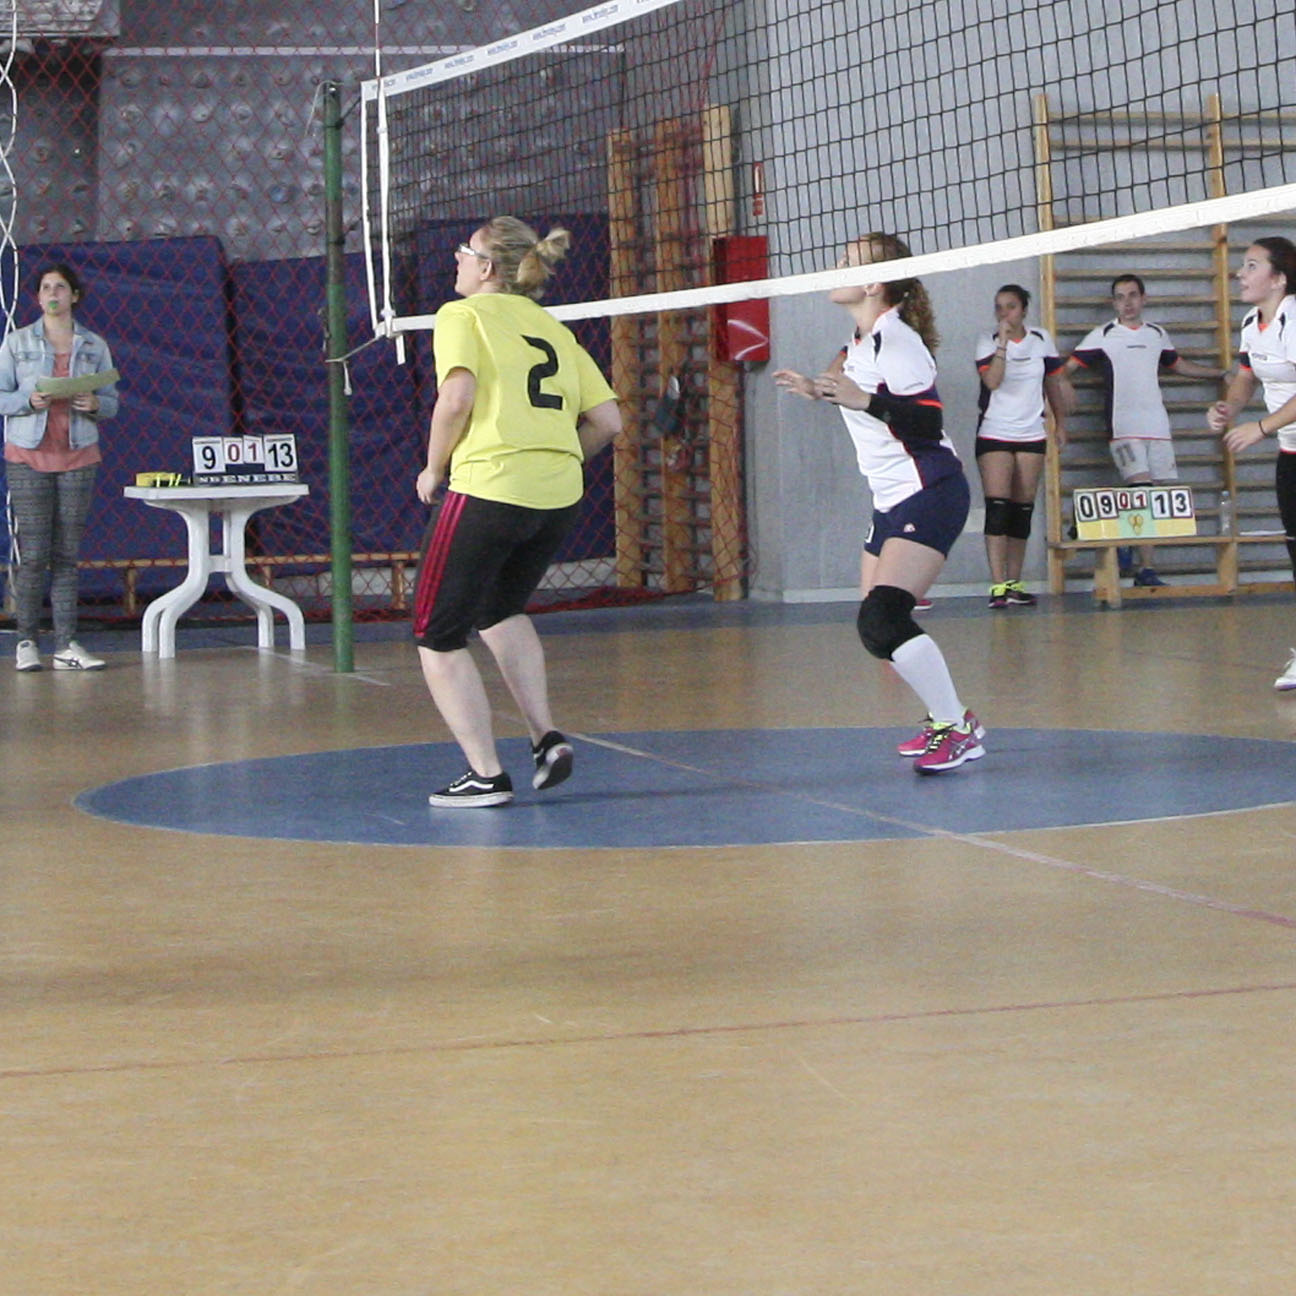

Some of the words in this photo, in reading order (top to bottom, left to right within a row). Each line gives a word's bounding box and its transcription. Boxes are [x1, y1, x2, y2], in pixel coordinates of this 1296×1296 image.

[520, 333, 564, 411] 2
[202, 445, 216, 470] 9
[267, 442, 294, 468] 13
